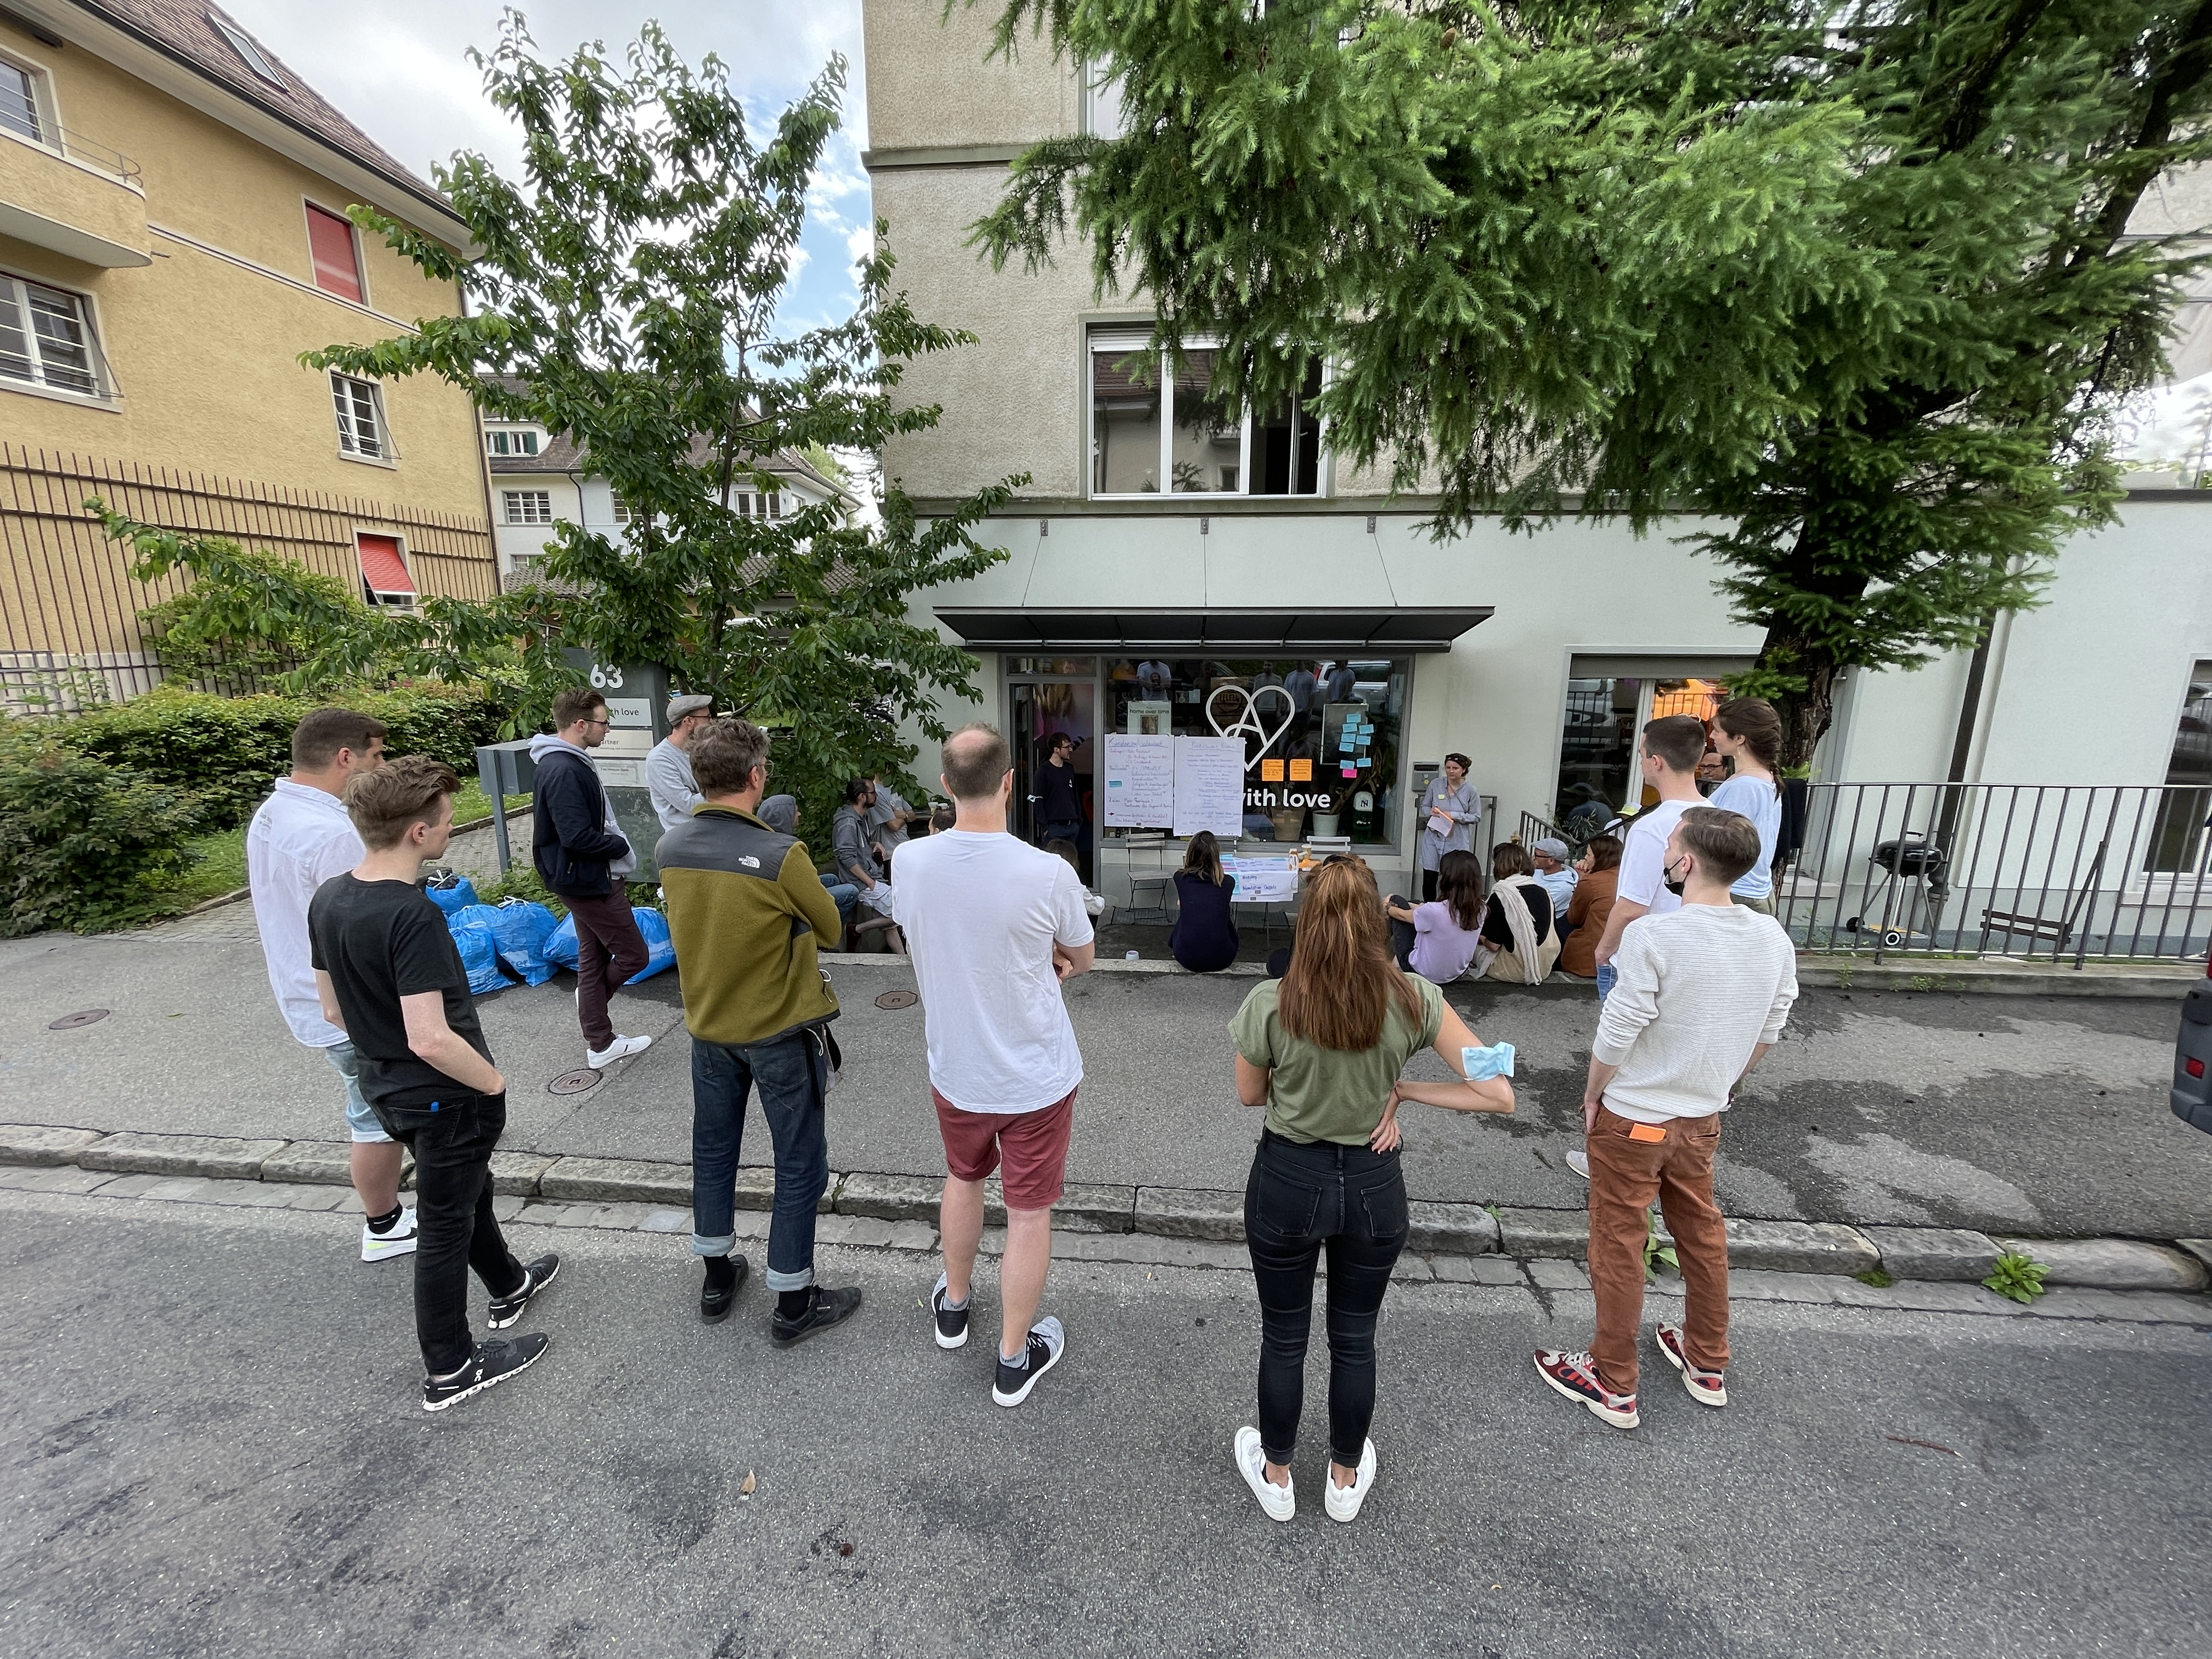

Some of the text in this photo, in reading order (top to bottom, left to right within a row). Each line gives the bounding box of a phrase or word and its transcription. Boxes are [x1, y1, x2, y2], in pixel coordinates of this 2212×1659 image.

[590, 664, 624, 689] 63
[621, 708, 639, 716] love
[1243, 788, 1277, 807] ith
[1283, 788, 1331, 808] love
